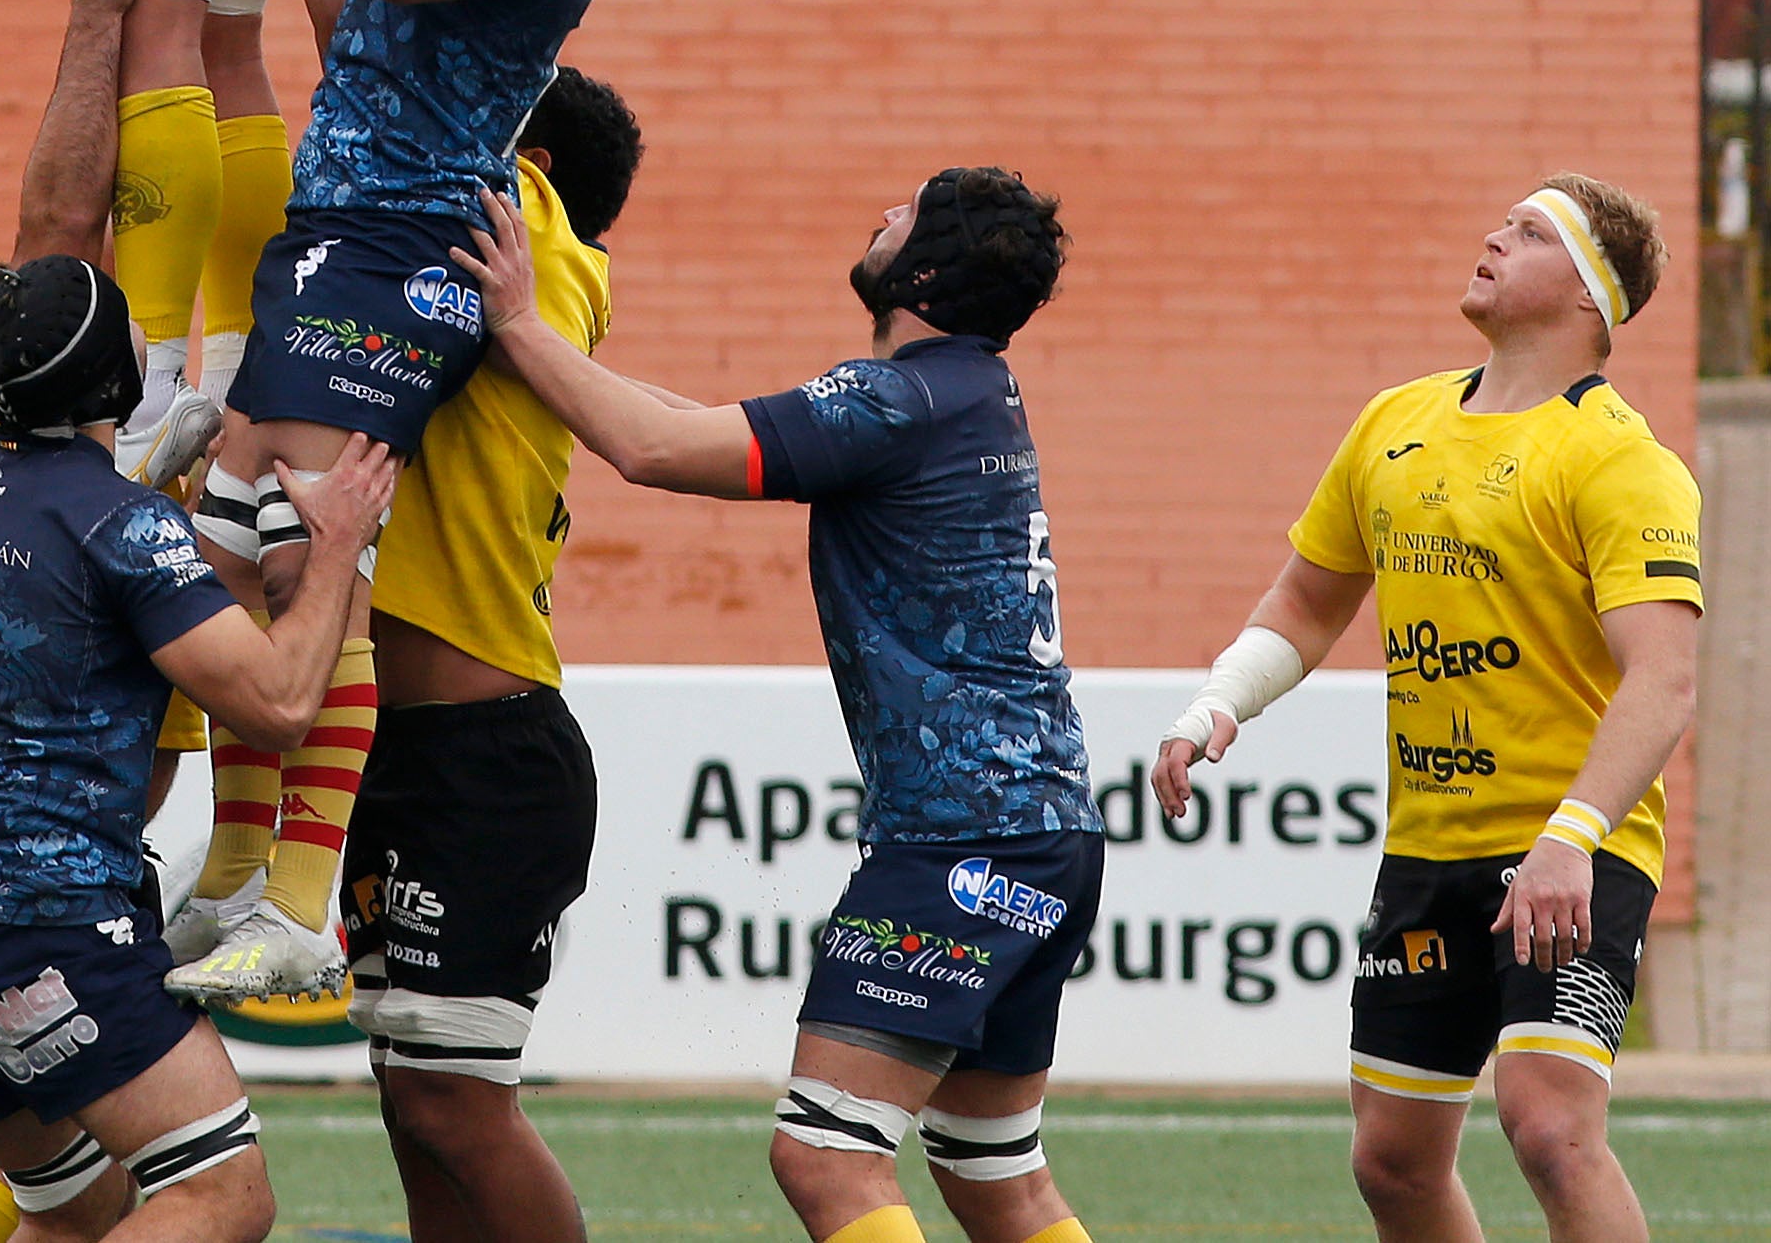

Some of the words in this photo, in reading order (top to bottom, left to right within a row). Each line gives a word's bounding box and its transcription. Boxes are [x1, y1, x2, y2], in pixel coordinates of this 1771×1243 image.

[407, 271, 481, 320] NAE
[284, 325, 342, 361] Villa
[328, 374, 396, 408] Kappa
[1027, 510, 1065, 670] 5
[1392, 554, 1410, 574] DE
[1412, 552, 1505, 583] BURGOS
[1386, 619, 1440, 665] AJO
[1417, 636, 1521, 683] CERO
[1395, 732, 1497, 784] Burgos
[682, 759, 1379, 864] Apadores
[1421, 779, 1475, 798] Gastronomy
[949, 859, 1068, 928] NAEKO
[825, 926, 879, 966] Villa
[855, 979, 929, 1009] Kappa
